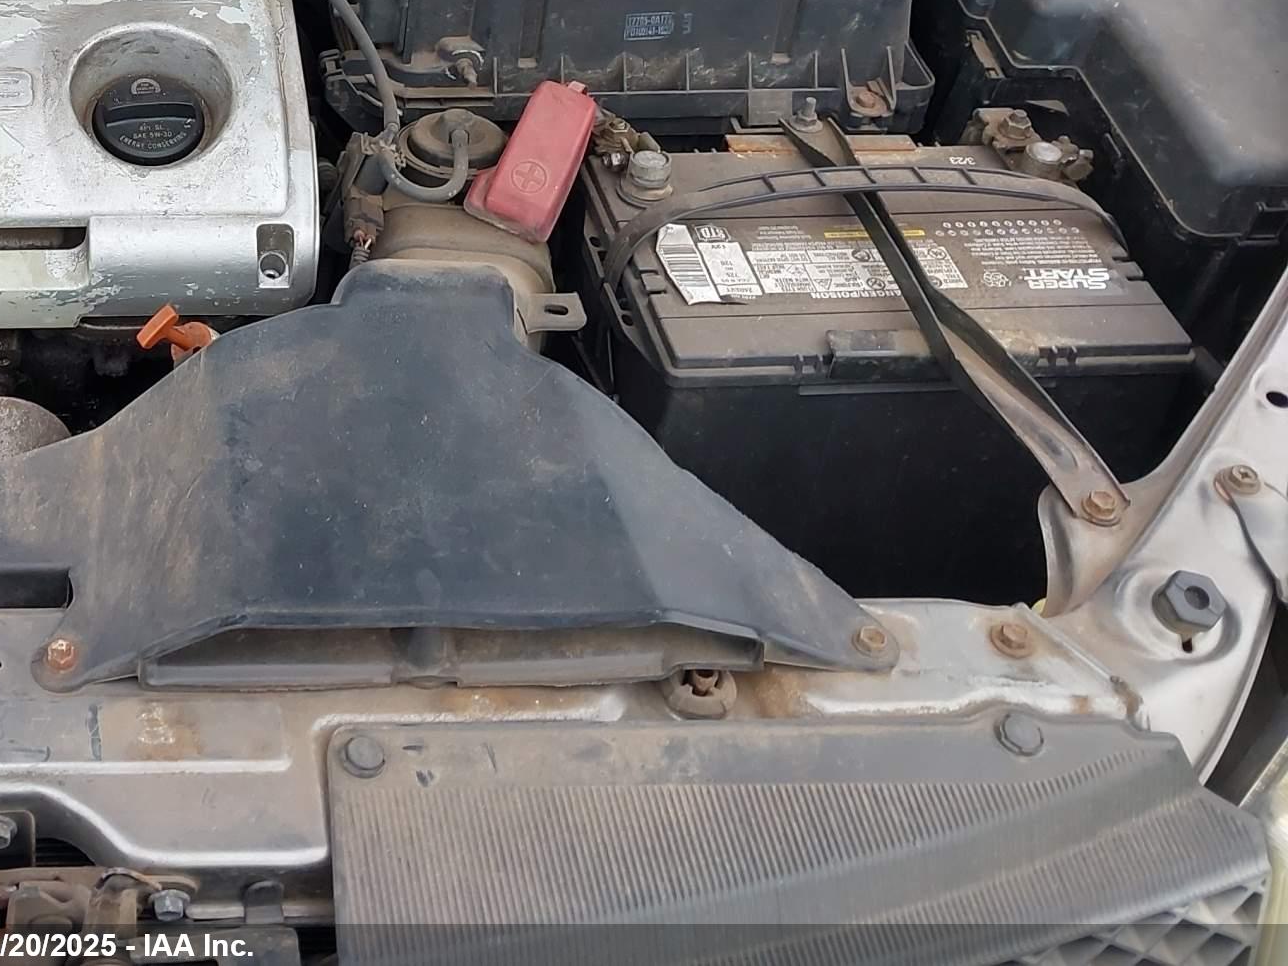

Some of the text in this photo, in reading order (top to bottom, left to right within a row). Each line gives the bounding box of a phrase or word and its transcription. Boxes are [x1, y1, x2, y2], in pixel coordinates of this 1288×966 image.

[133, 132, 147, 140] SAE
[119, 135, 145, 149] ENERGY
[1023, 267, 1110, 281] START
[1027, 279, 1107, 290] SUPER
[811, 289, 903, 299] ANGER/POISON
